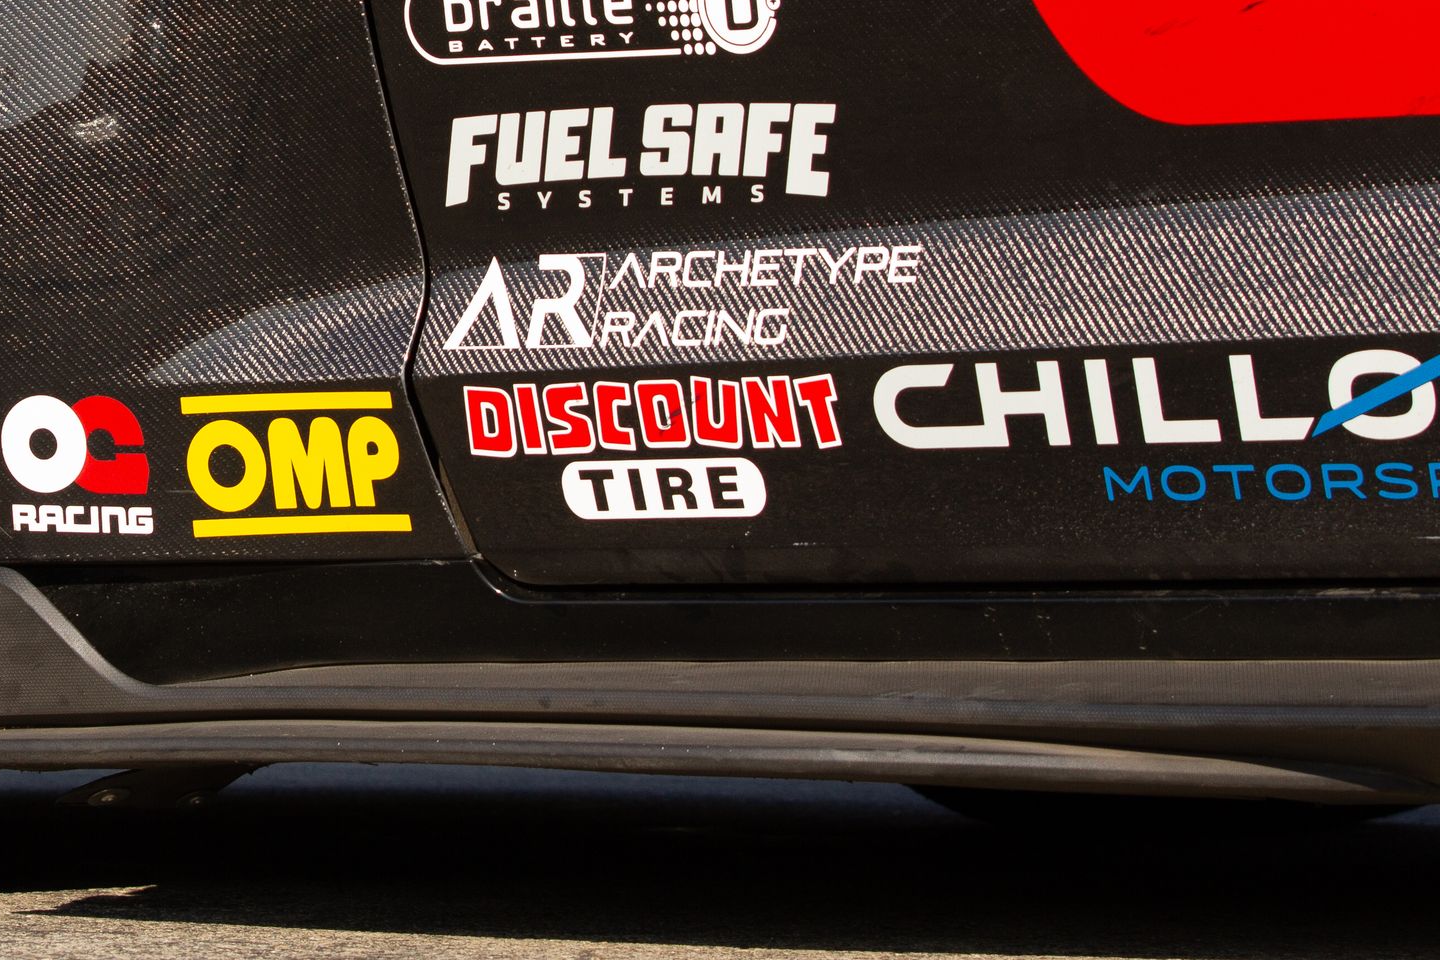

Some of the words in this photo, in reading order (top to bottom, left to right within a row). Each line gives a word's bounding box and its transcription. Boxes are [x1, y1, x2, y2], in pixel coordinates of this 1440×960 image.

[447, 30, 637, 53] BATTERY
[445, 106, 627, 208] FUEL
[638, 102, 837, 197] SAFE
[496, 183, 766, 211] SYSTEMS
[608, 244, 922, 289] ARCHETYPE
[598, 306, 790, 348] RACING
[463, 373, 843, 459] DISCOUNT
[186, 415, 400, 513] OMP
[578, 466, 746, 512] TIRE
[12, 503, 155, 536] RACING
